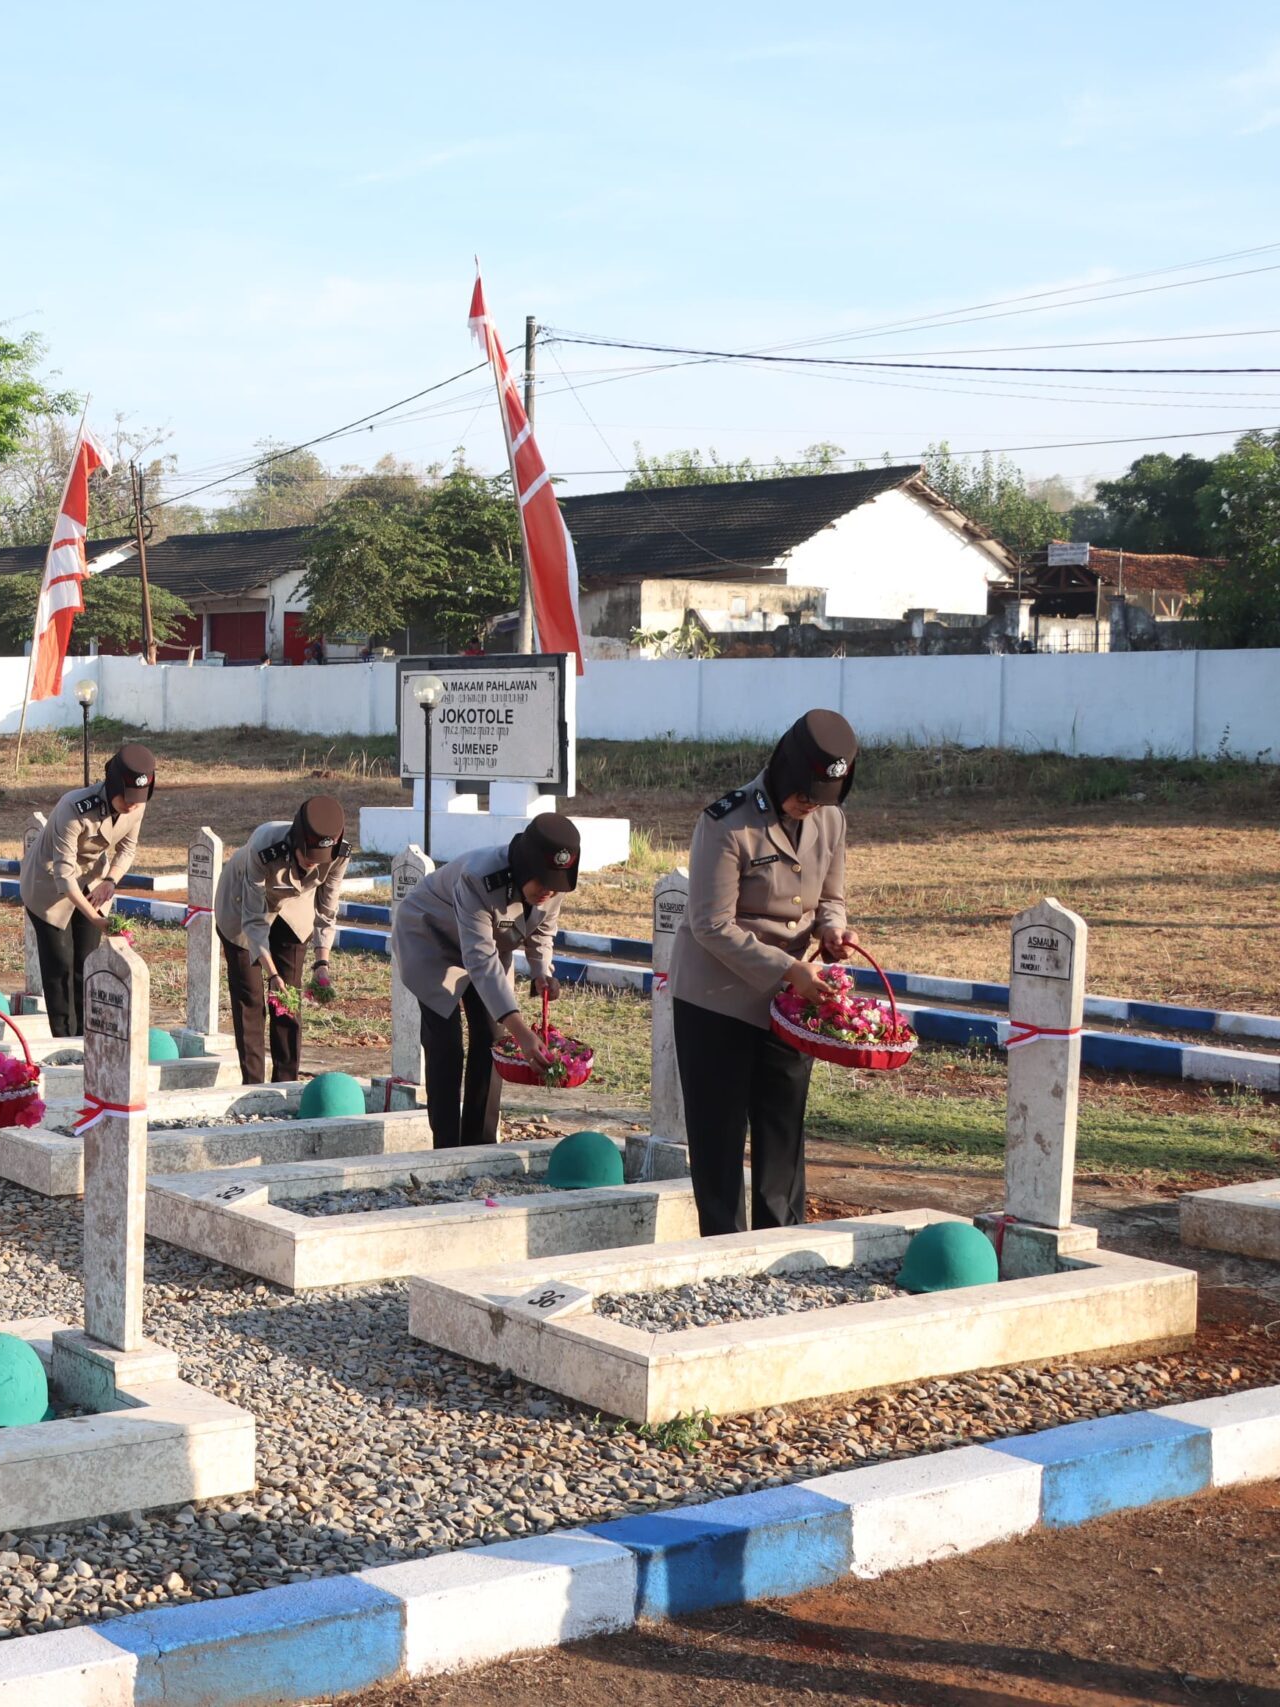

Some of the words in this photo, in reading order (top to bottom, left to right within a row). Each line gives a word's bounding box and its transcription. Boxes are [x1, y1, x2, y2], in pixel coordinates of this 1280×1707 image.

[451, 681, 483, 691] MAKAM
[486, 680, 537, 691] PAHLAWAN
[439, 708, 514, 724] JOKOTOLE
[451, 743, 498, 755] SUMENEP
[216, 1186, 245, 1199] 32
[528, 1290, 565, 1308] 36
